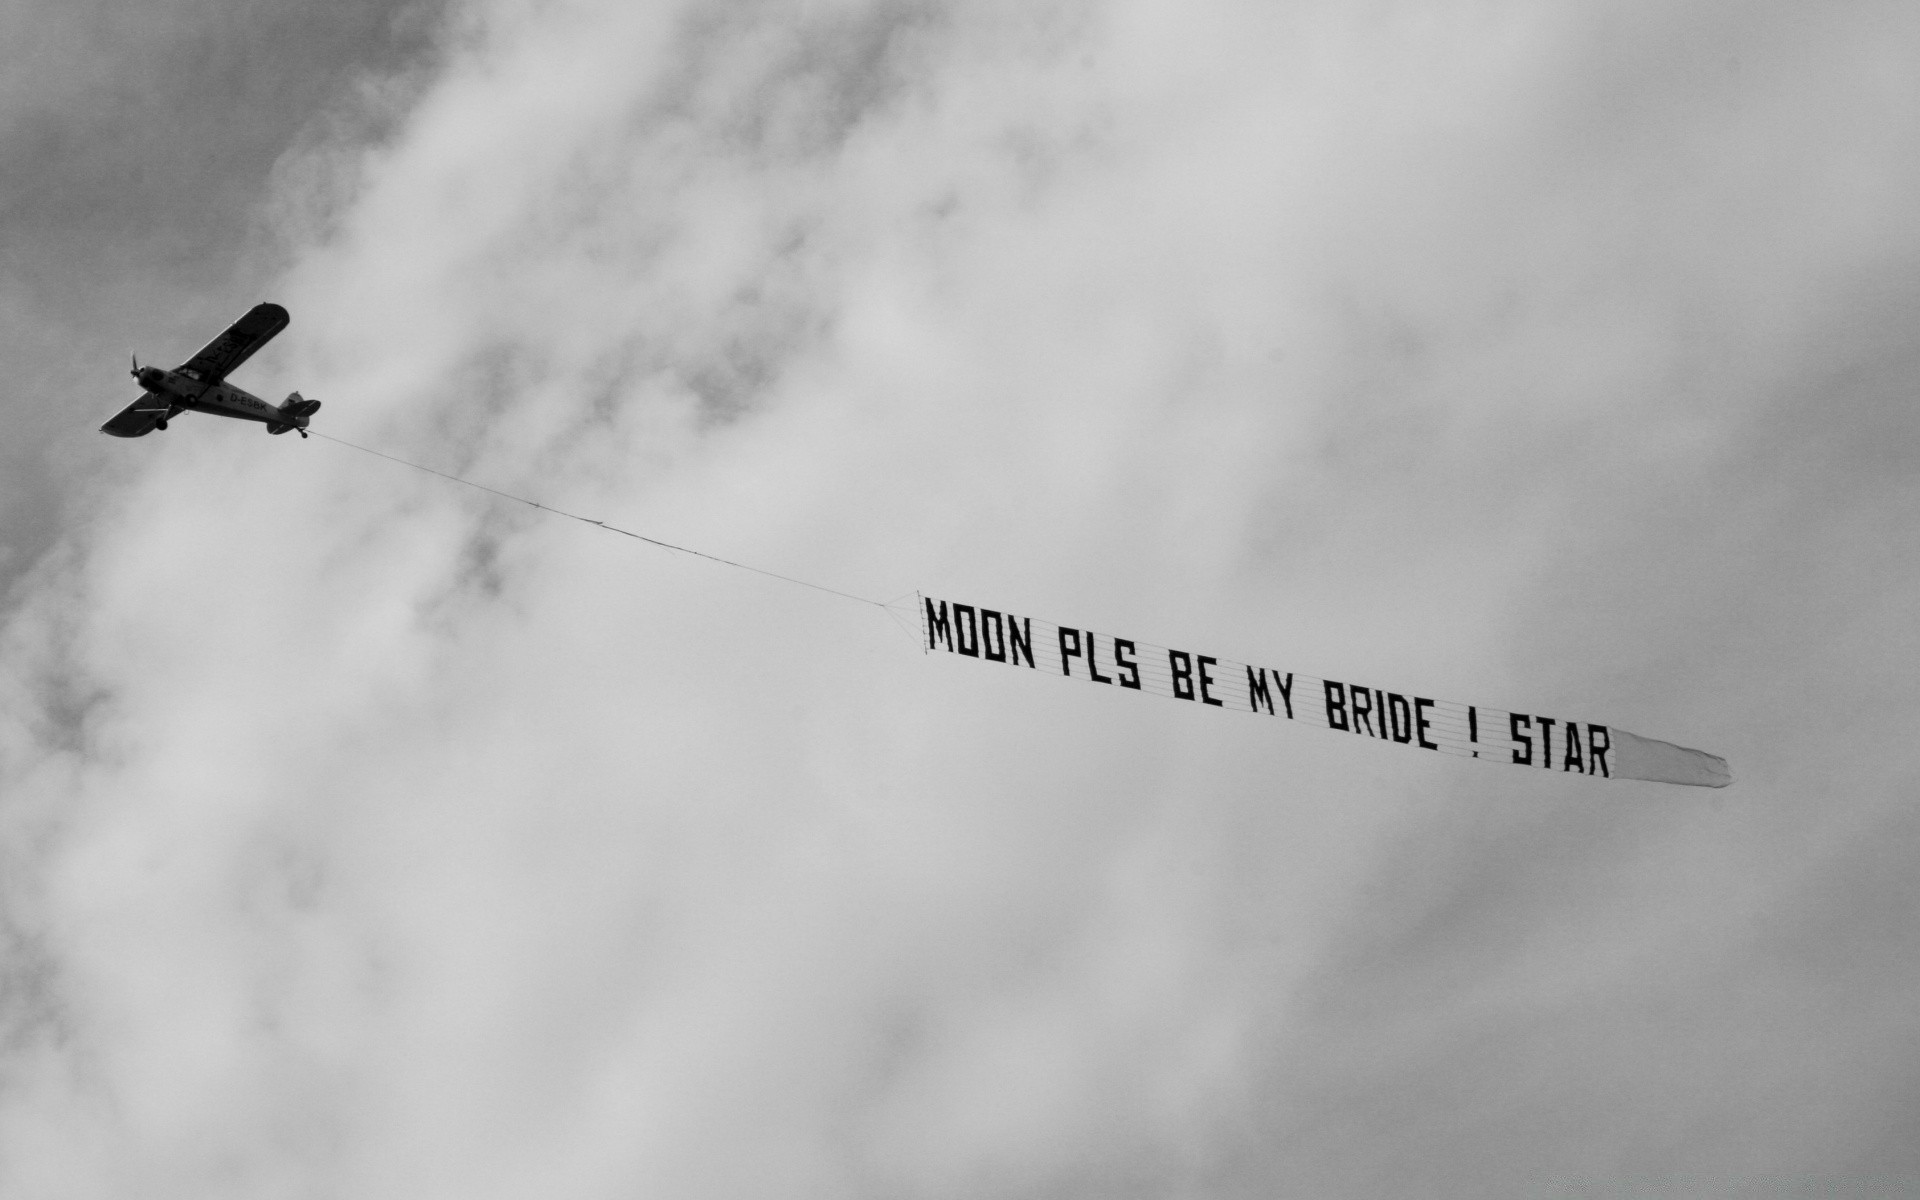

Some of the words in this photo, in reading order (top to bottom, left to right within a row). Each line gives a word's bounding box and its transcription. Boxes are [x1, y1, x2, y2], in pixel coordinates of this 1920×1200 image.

[230, 393, 267, 411] D-ESBK
[925, 597, 1036, 669] MOON
[1058, 626, 1141, 691] PLS
[1168, 649, 1223, 707] BE
[1246, 665, 1293, 720] MY
[1323, 679, 1438, 751] BRIDE
[1467, 705, 1479, 758] !
[1509, 712, 1611, 779] STAR
